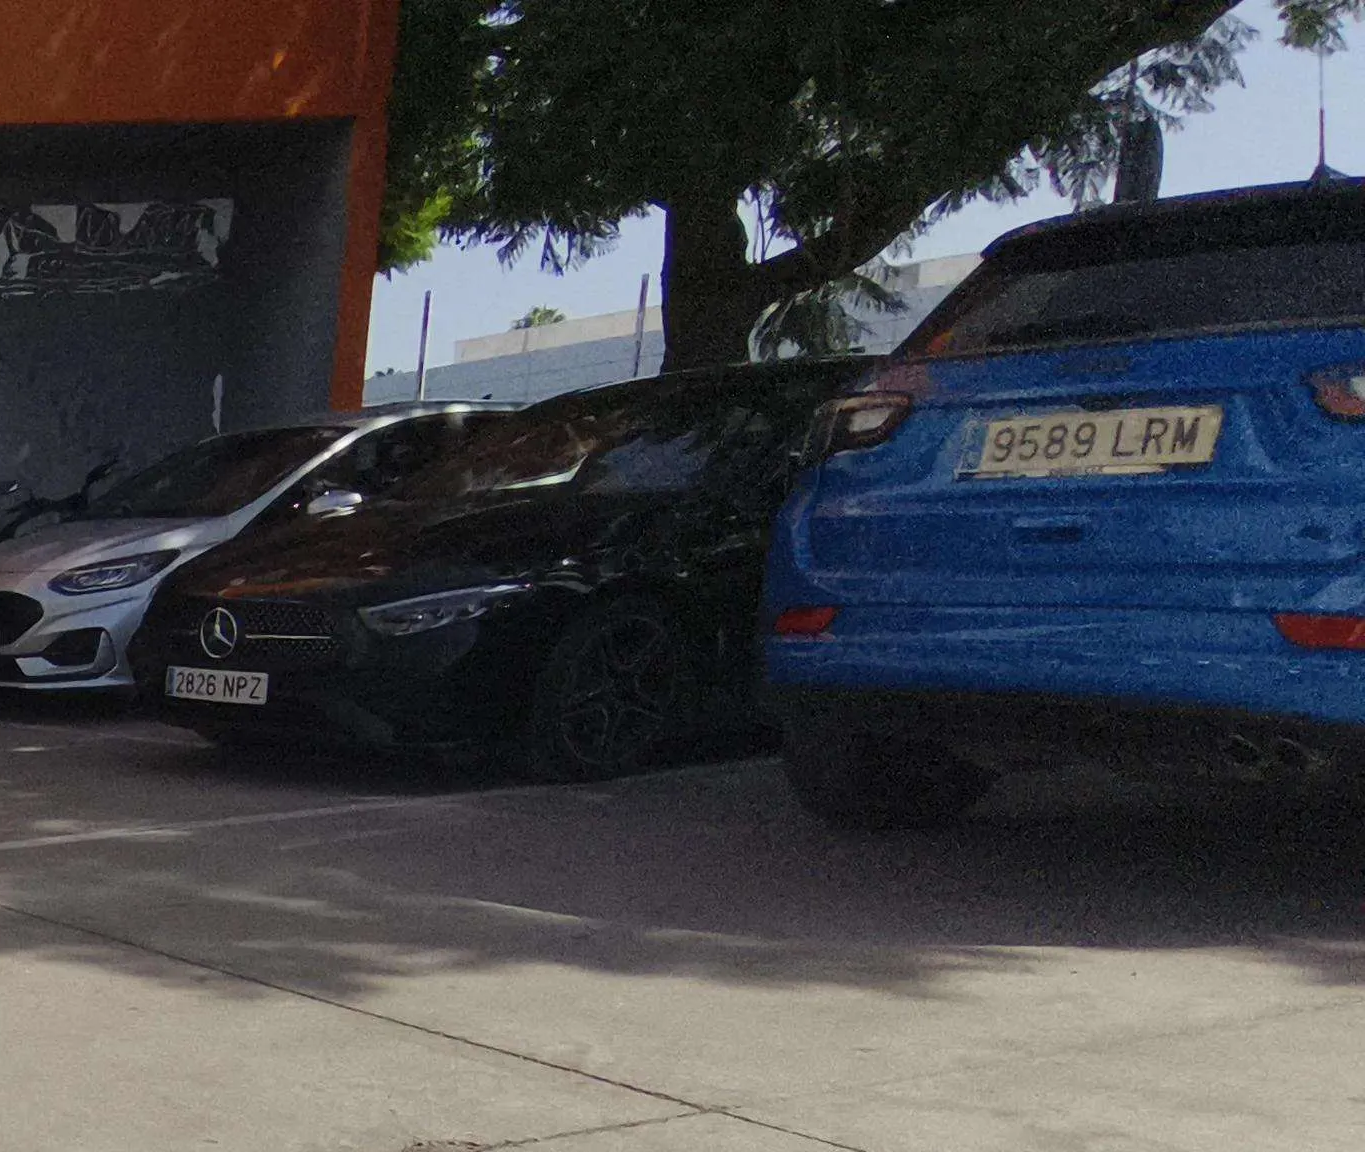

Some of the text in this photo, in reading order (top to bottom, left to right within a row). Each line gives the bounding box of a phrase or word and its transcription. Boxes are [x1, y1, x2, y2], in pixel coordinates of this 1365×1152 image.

[992, 415, 1201, 463] 9589 LRM
[175, 671, 264, 699] 2826 NPZ
